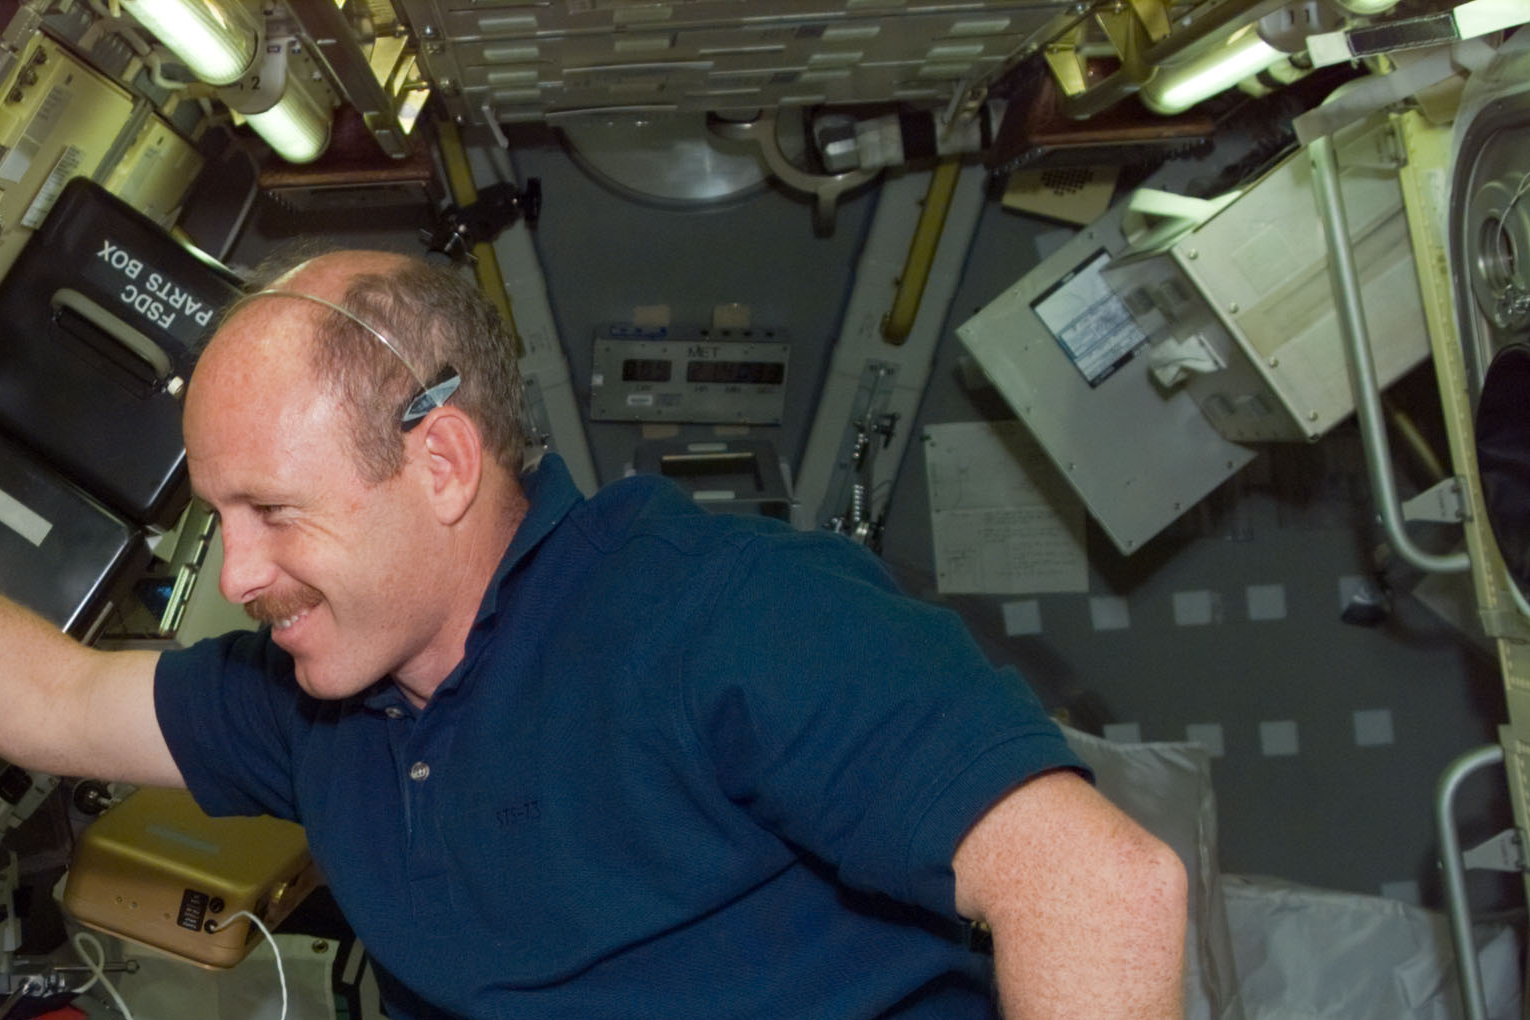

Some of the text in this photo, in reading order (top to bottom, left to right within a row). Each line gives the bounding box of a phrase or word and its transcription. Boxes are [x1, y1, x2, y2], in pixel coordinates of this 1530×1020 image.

[96, 239, 213, 326] PARTS BOX
[121, 284, 176, 329] FSDC
[687, 346, 720, 358] MET
[496, 800, 541, 828] STS-73
